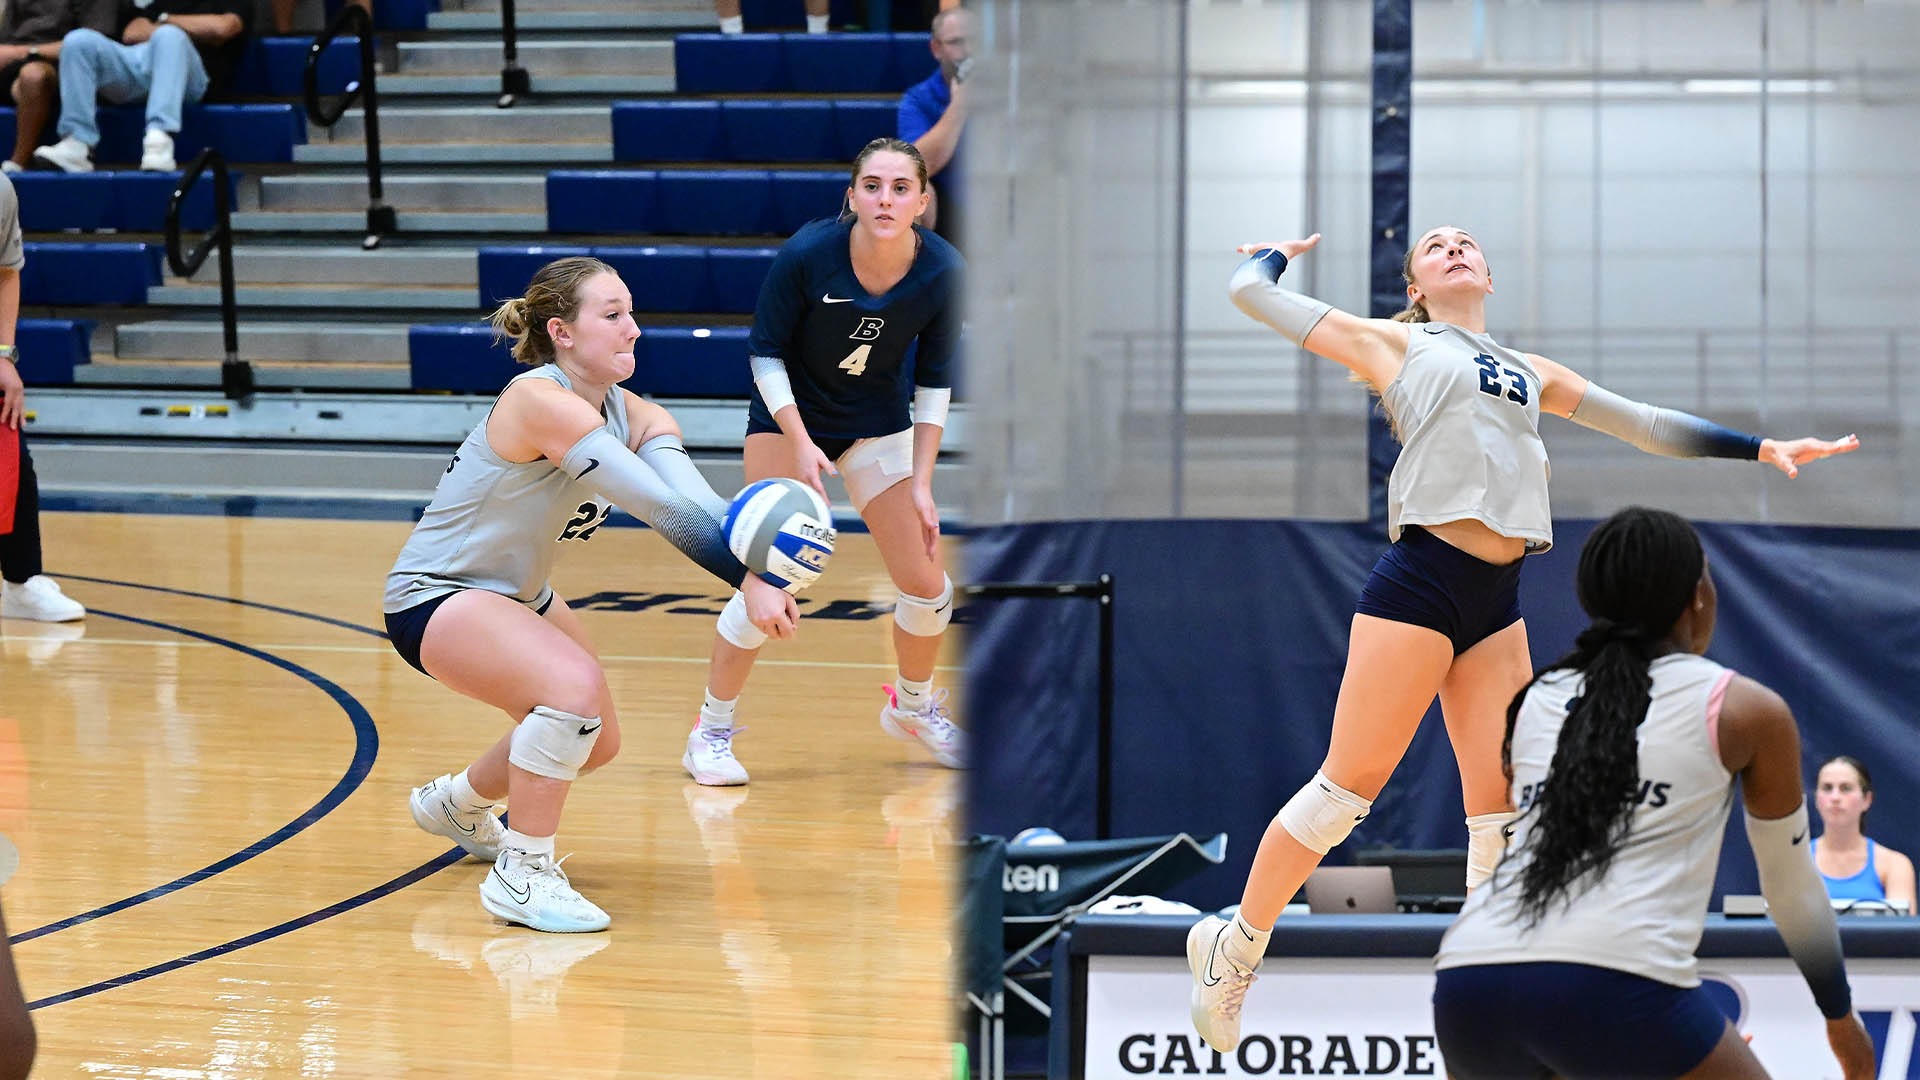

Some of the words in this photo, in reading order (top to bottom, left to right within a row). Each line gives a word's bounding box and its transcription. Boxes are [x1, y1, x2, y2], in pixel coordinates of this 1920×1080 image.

[849, 316, 885, 341] B
[838, 344, 872, 376] 4
[1472, 351, 1530, 407] 23
[1002, 864, 1059, 892] ten
